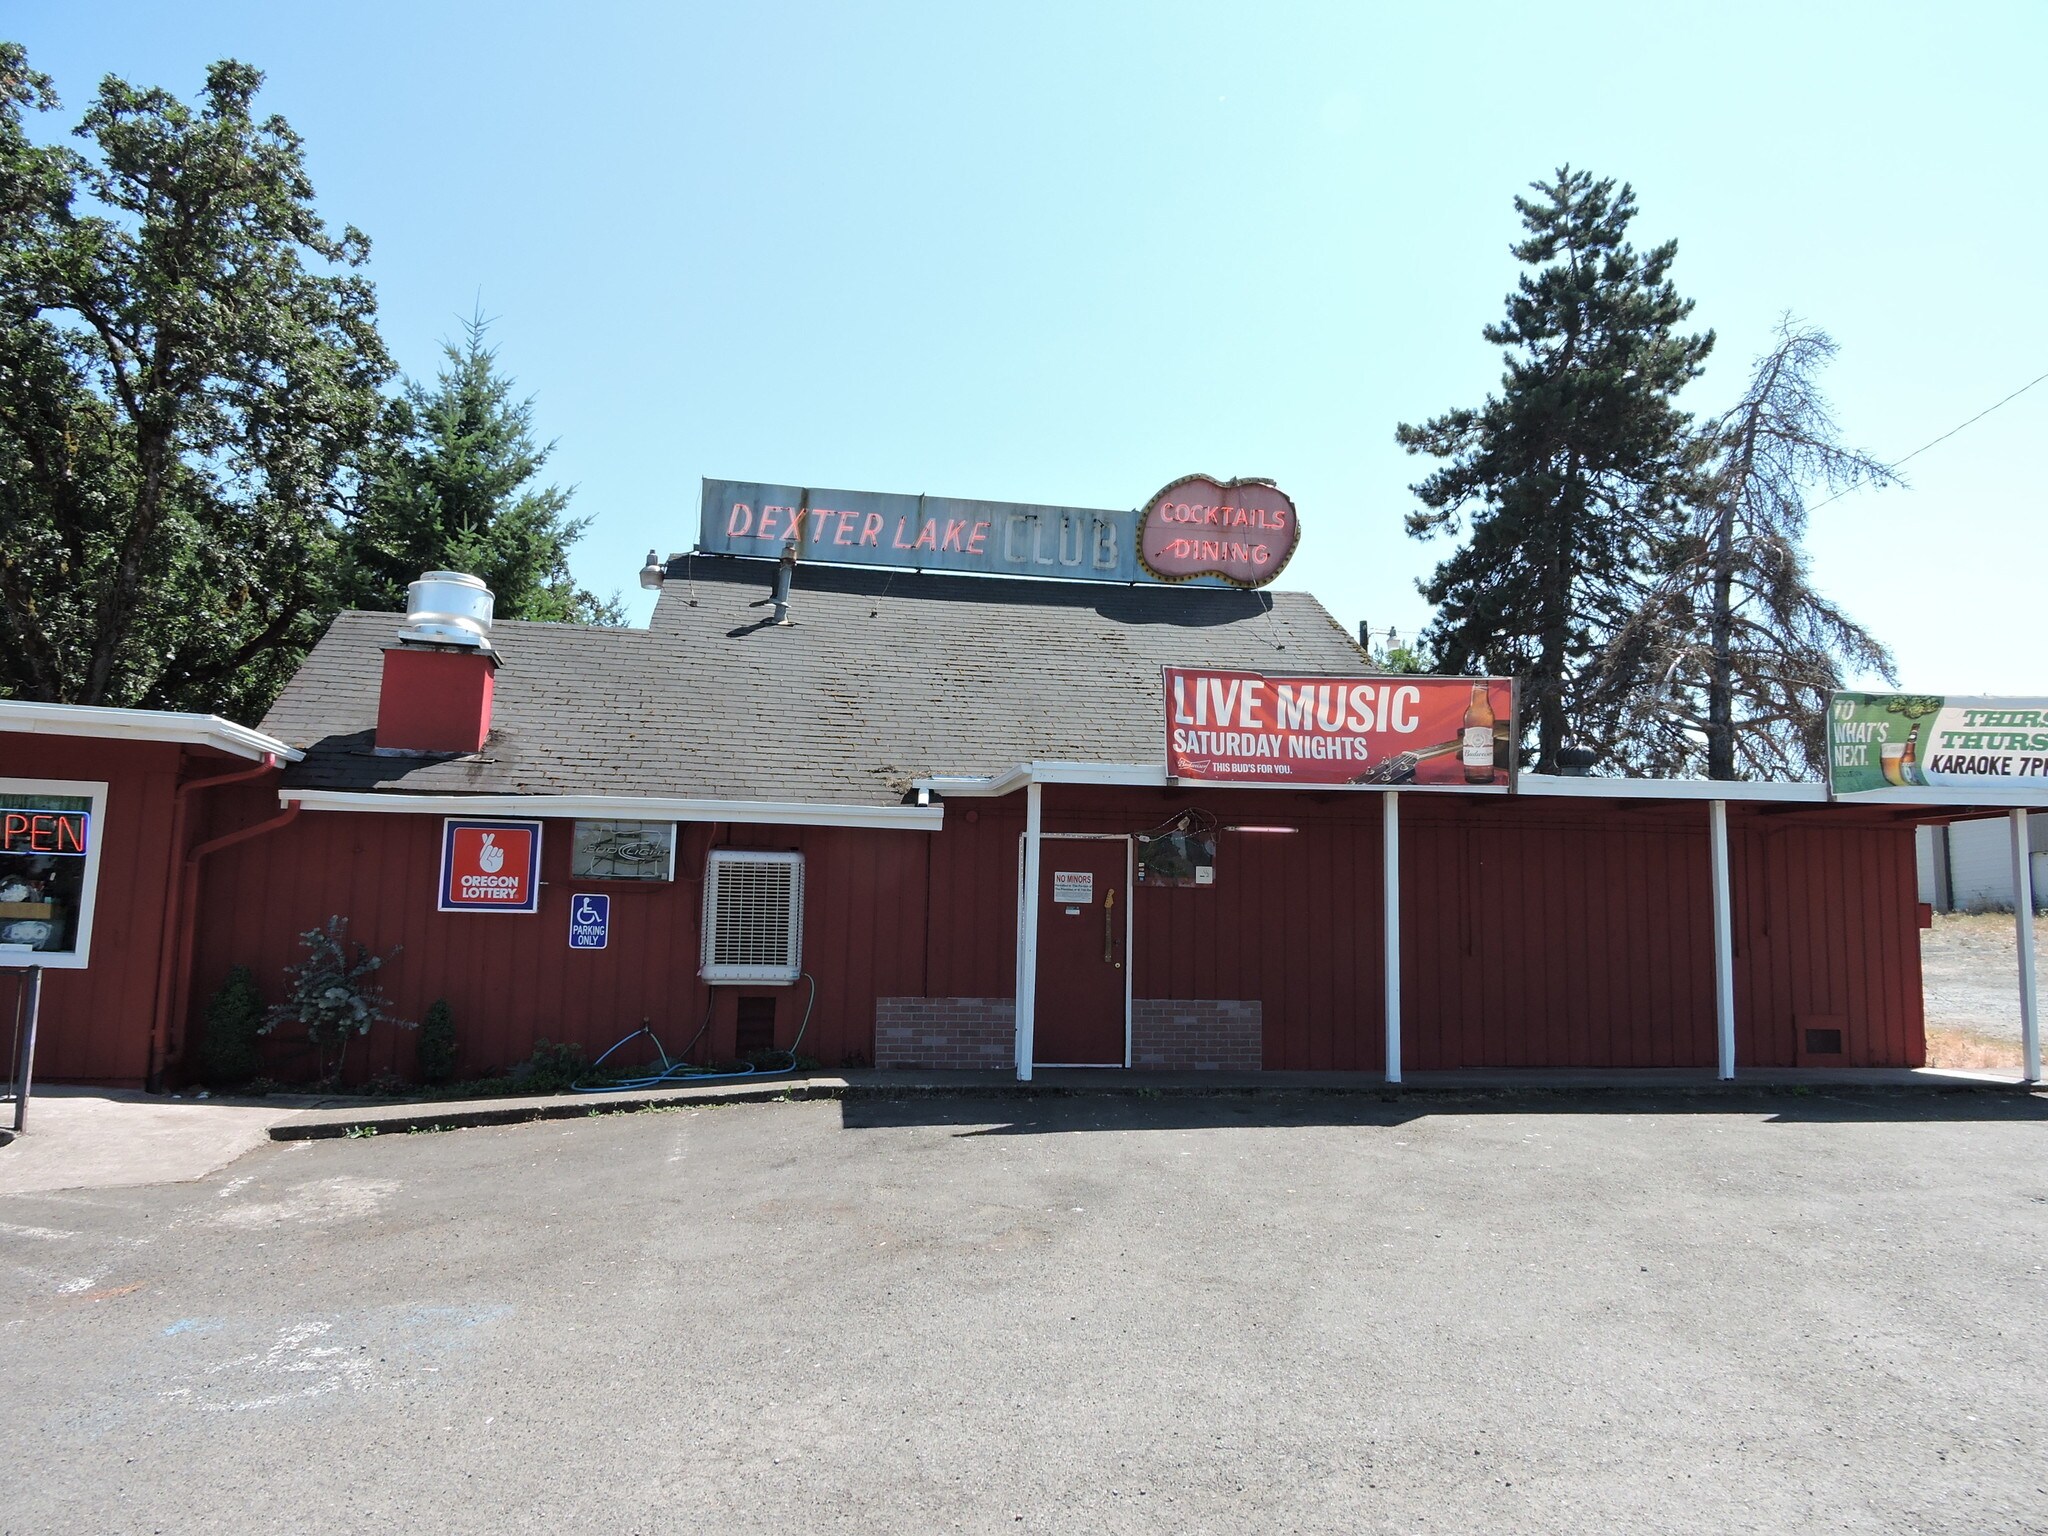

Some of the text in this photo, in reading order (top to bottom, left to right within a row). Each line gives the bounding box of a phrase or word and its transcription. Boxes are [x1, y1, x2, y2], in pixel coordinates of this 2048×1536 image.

[1159, 501, 1286, 530] COCKTAILS
[726, 503, 1119, 569] DEXTER LAKE CLUB
[1173, 538, 1271, 565] DINING
[1173, 675, 1421, 734] LIVE MUSIC
[1833, 699, 1856, 721] TO
[1963, 709, 2048, 729] THIR
[1833, 722, 1890, 744] WHAT'S
[1172, 728, 1369, 761] SATURDAY NIGHTS
[1834, 744, 1869, 767] NEXT.
[1212, 762, 1293, 774] THIS BUD'S FOR YOU.
[1930, 754, 2013, 776] KARAOKE
[582, 845, 670, 856] BUD LIGHT
[461, 875, 519, 887] OREGON
[1056, 874, 1091, 884] NO MINORS
[462, 887, 517, 899] LOTTERY
[573, 925, 605, 936] PARKING
[578, 935, 599, 946] ONLY
